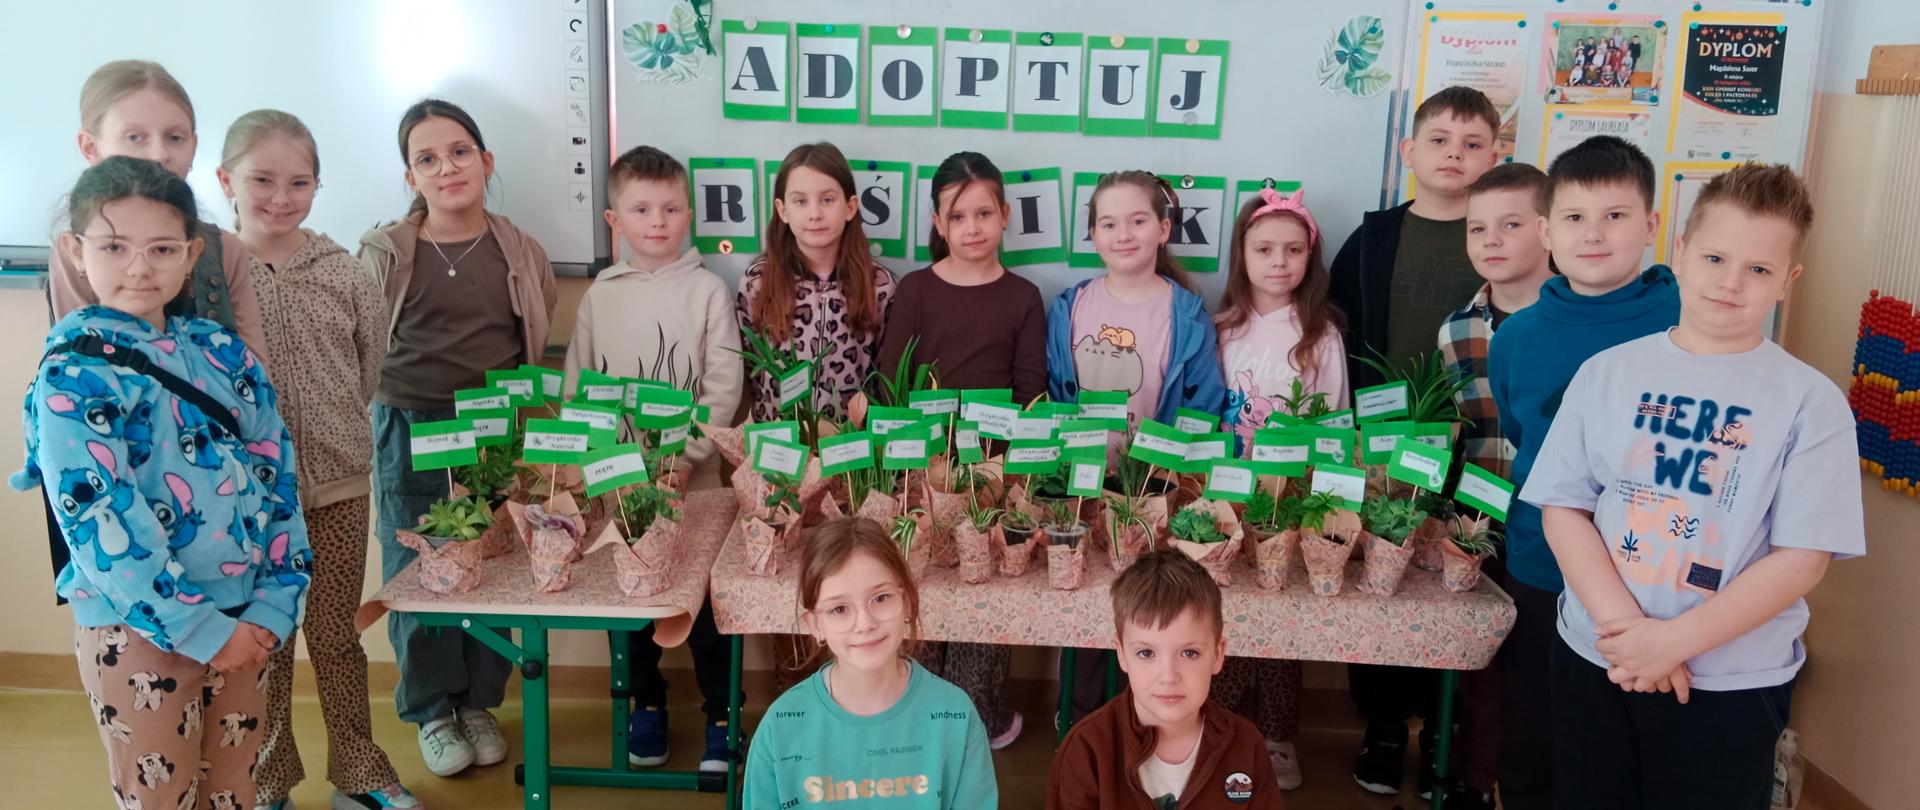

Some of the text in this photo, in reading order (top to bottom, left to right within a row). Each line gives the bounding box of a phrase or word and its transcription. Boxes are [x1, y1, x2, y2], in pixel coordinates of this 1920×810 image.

[1699, 42, 1773, 58] DYPLOM
[1709, 65, 1741, 73] Magdalena
[731, 46, 1207, 110] ADOPTUJ
[1569, 119, 1596, 132] DYPLOM
[1634, 392, 1752, 449] HERE
[1655, 442, 1718, 496] WE
[776, 710, 805, 719] forever
[930, 710, 967, 720] kindness
[803, 774, 929, 803] Sincere
